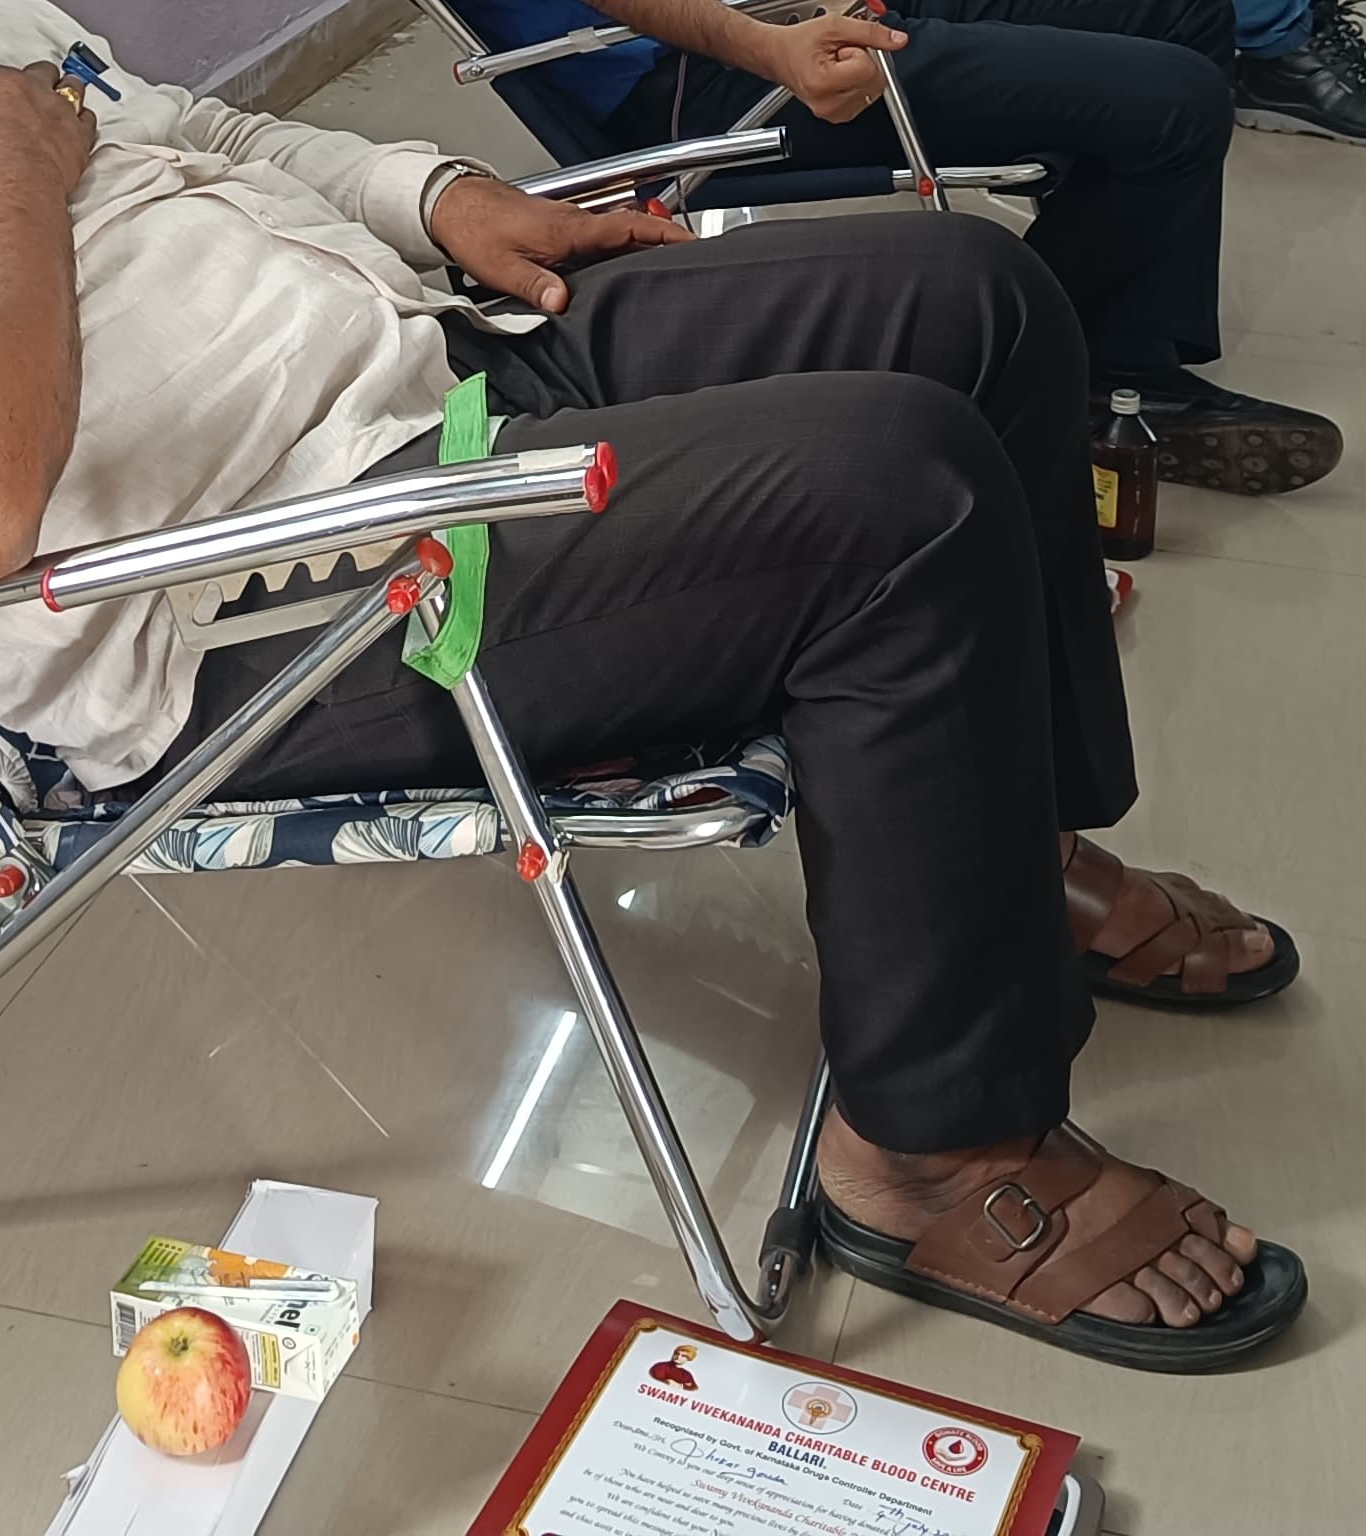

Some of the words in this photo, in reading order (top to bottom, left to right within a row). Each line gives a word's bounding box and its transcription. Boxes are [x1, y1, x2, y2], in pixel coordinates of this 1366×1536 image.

[637, 1383, 688, 1407] SWAMY
[690, 1400, 781, 1438] VIVEKANANDA
[785, 1431, 869, 1467] CHARITABLE
[871, 1459, 918, 1483] BLOOD
[920, 1475, 977, 1503] CENTRE
[653, 1416, 705, 1439] Recognised
[706, 1434, 717, 1445] by
[719, 1439, 742, 1452] Govt.
[756, 1451, 801, 1471] Karnataka
[802, 1466, 830, 1481] Drugs
[831, 1476, 877, 1496] Controller
[878, 1492, 933, 1516] Department
[768, 1440, 827, 1470] BALLARI.
[765, 1490, 814, 1510] appreciation
